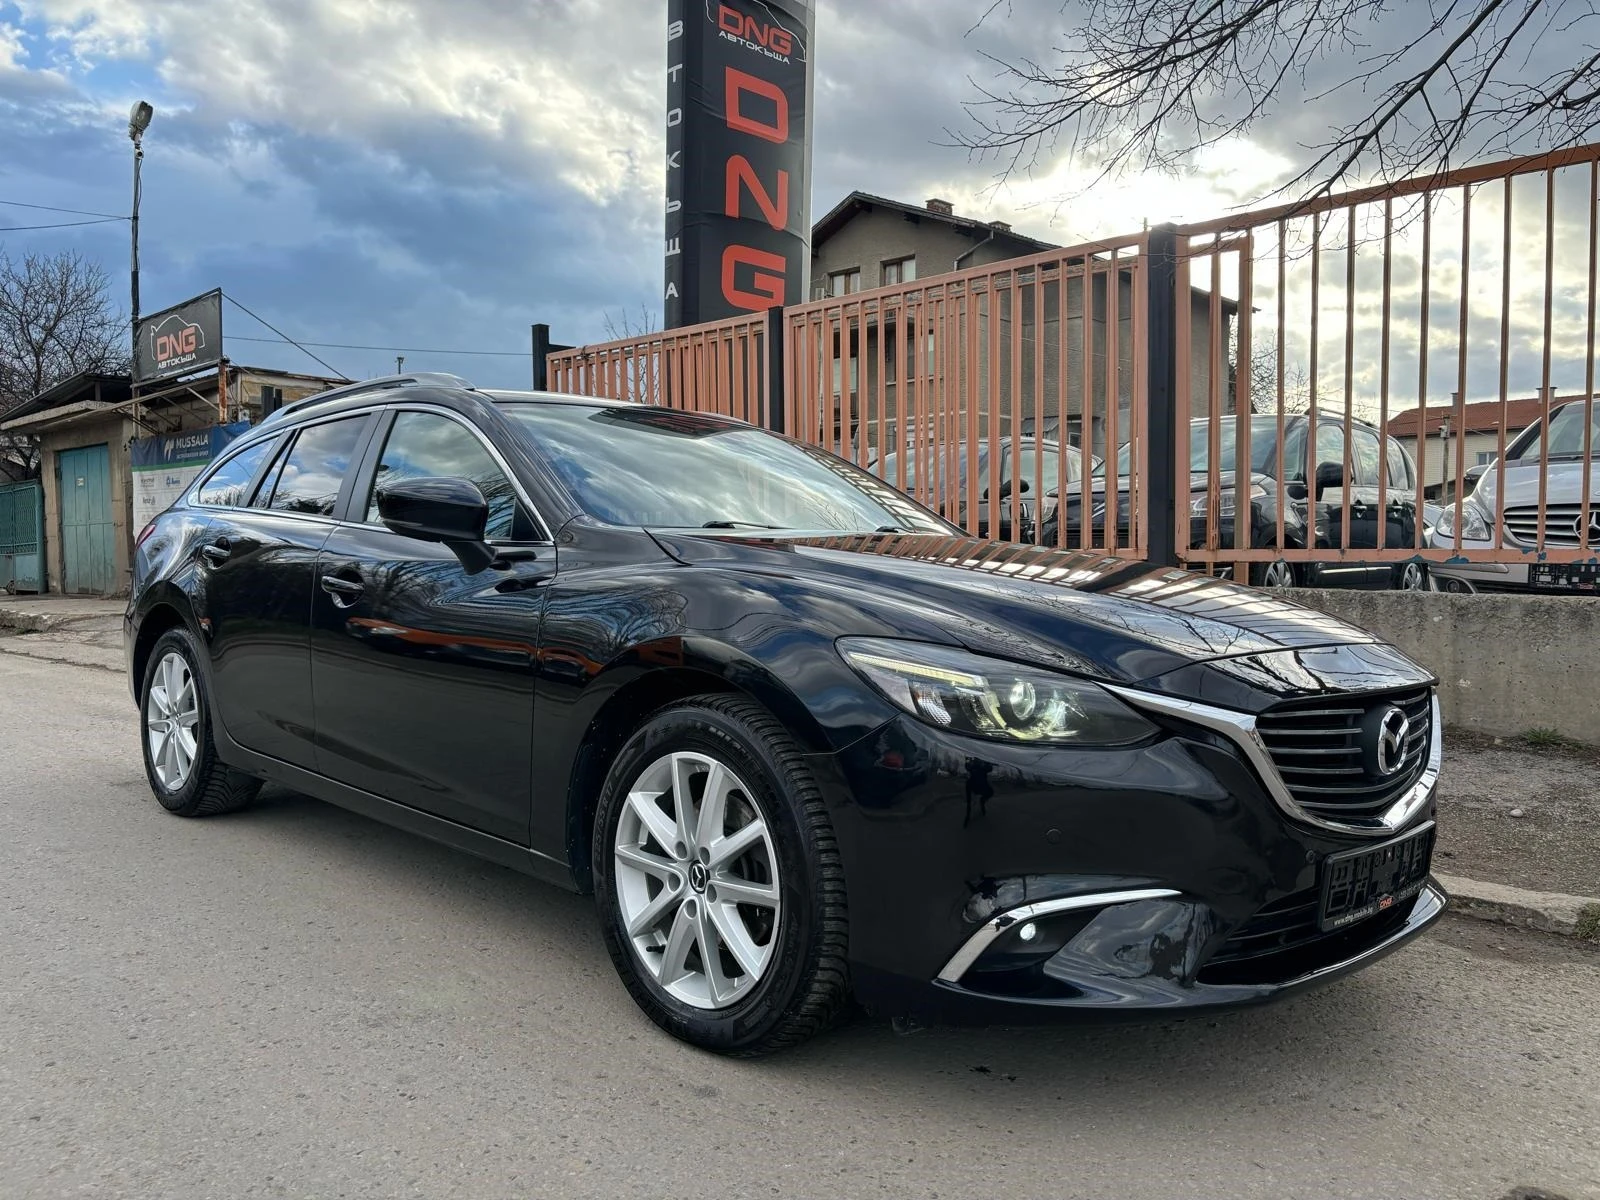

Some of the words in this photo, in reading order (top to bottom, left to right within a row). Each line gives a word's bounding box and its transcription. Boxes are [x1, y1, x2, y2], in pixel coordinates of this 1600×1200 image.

[718, 4, 792, 56] DNG
[721, 66, 789, 311] DNG
[157, 326, 196, 361] DNG
[176, 433, 209, 449] MUSSALA
